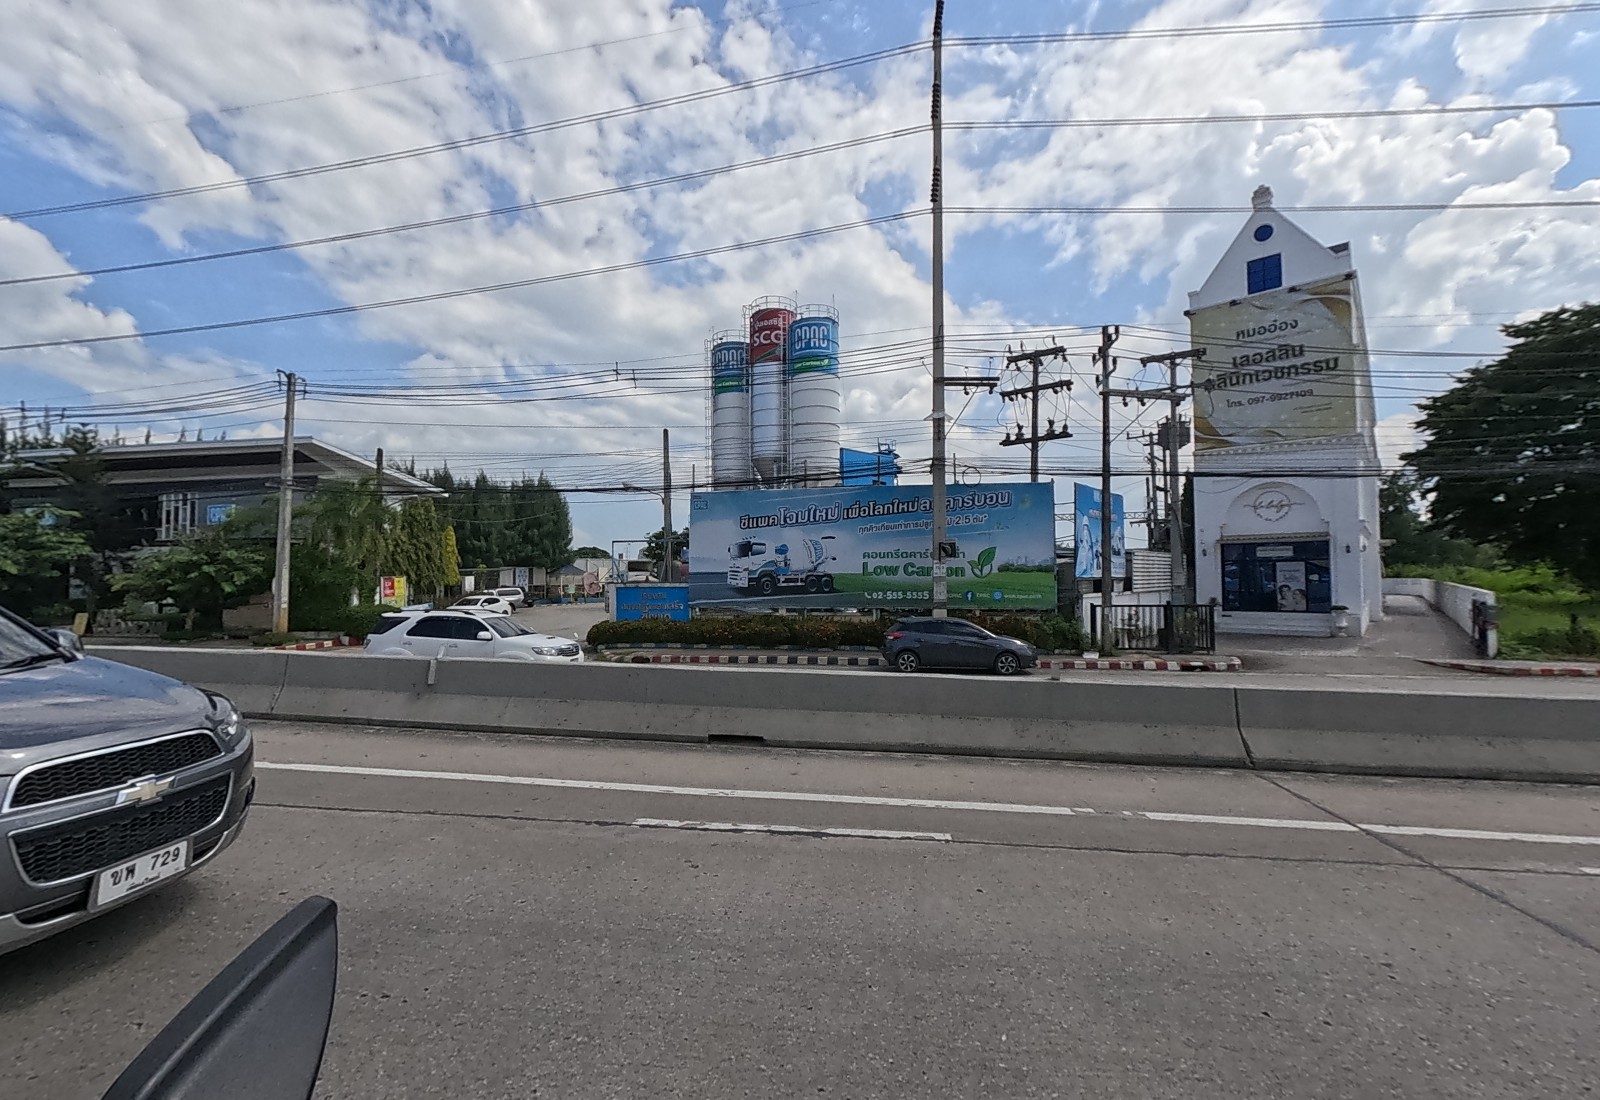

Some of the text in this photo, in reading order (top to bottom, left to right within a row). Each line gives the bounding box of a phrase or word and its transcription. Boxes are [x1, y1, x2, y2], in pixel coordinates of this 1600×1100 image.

[753, 330, 784, 347] SCG
[794, 325, 828, 350] CPAC
[955, 515, 971, 525] 2.5
[862, 562, 900, 577] Low
[903, 561, 966, 577] Caron
[872, 590, 930, 600] 02-555-5555
[110, 863, 137, 887] ขพ
[150, 846, 181, 871] 729
